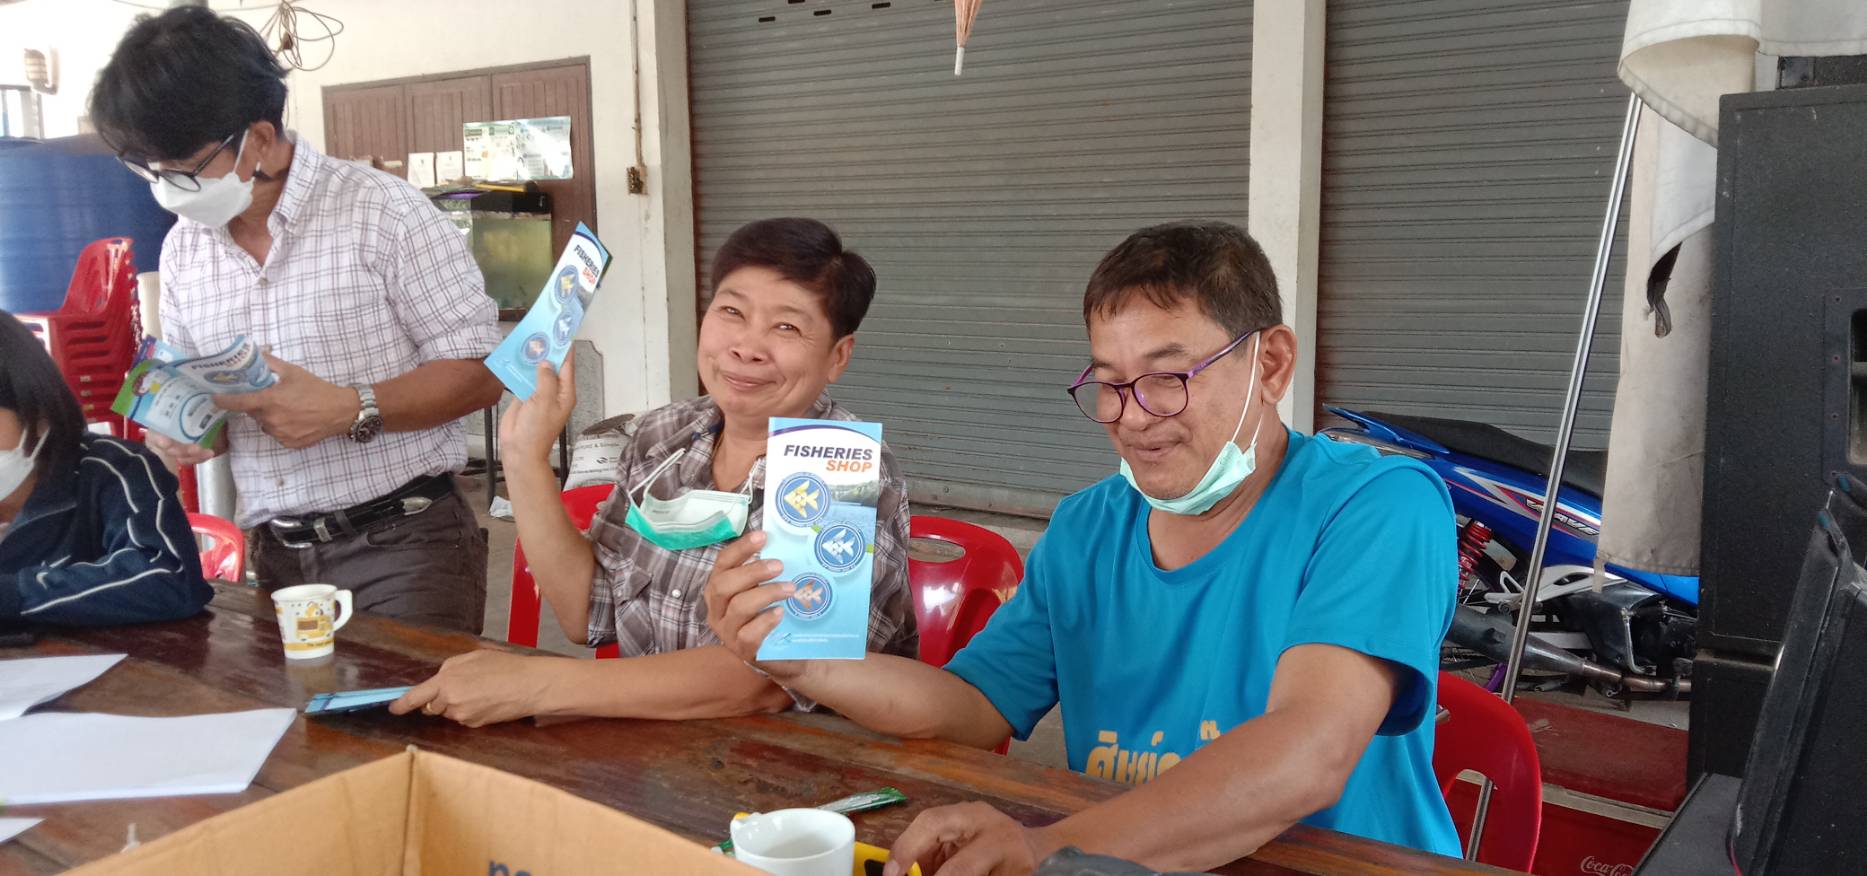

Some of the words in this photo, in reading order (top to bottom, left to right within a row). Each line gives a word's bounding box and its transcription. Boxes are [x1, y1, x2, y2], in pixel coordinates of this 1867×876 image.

[574, 244, 600, 278] FISHERIES
[784, 445, 873, 461] FISHERIES
[825, 459, 873, 473] SHOP
